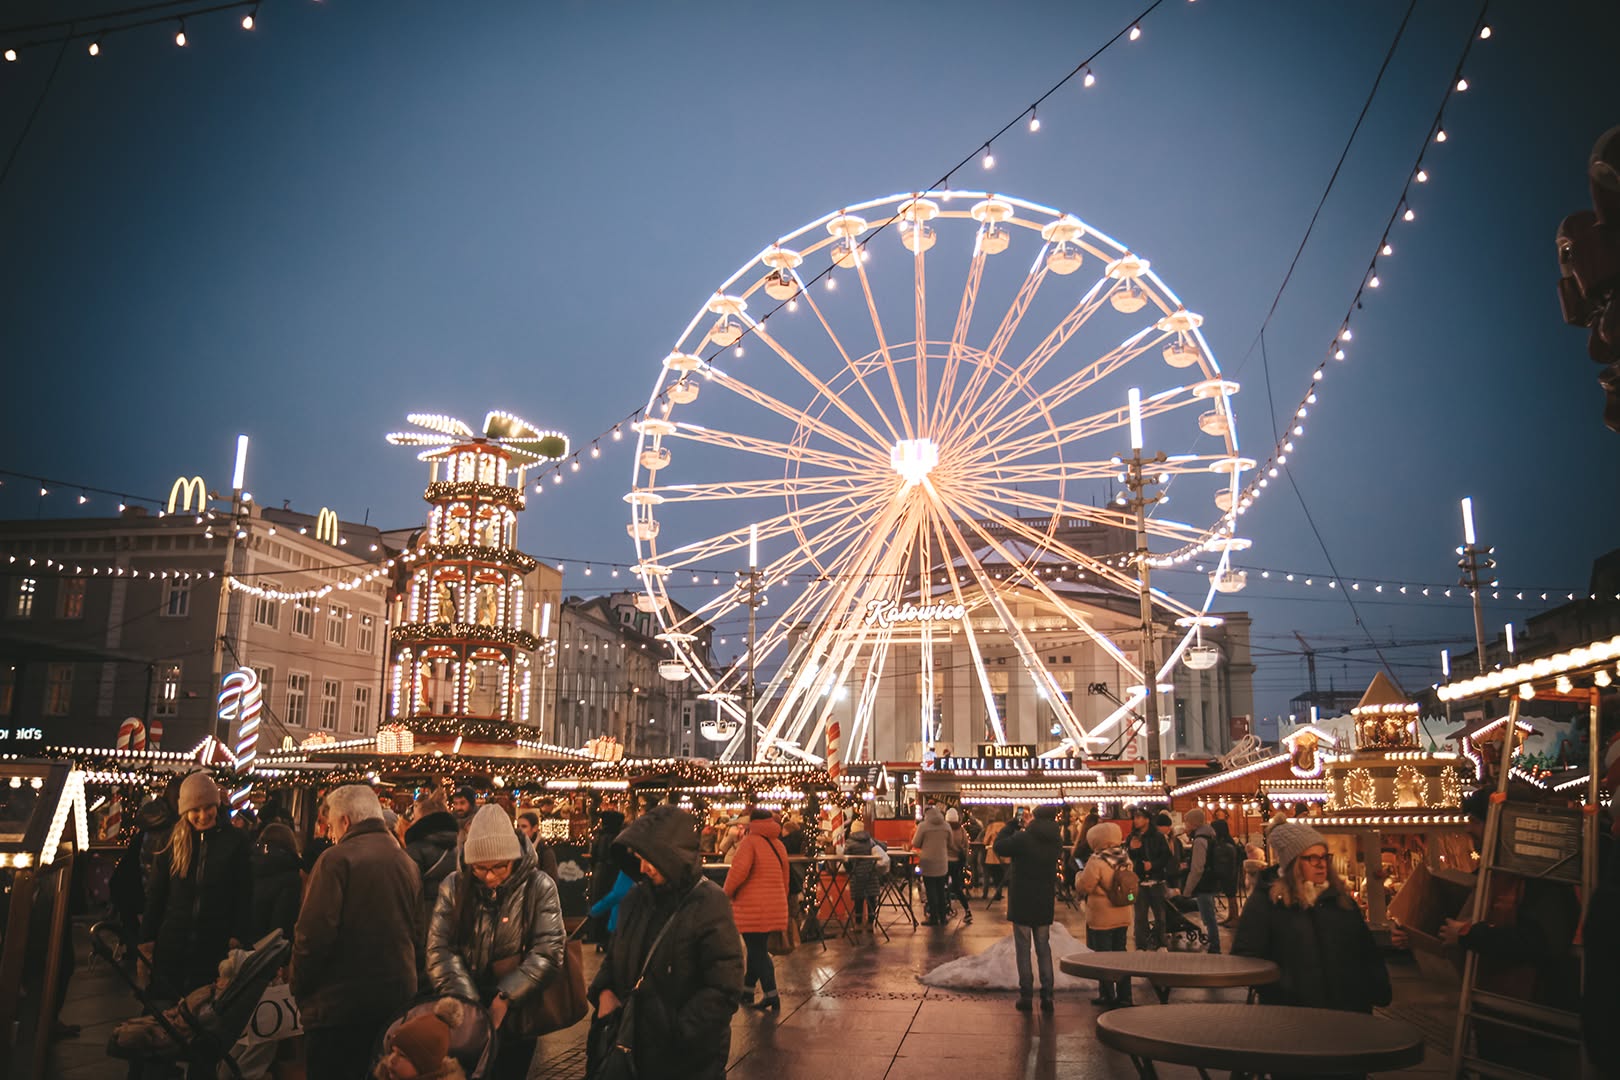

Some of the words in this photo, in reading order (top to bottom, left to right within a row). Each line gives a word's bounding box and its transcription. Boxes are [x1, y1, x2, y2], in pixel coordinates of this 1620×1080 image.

[865, 599, 966, 629] Katowice
[995, 746, 1029, 757] BULWA
[940, 757, 985, 770] FRYTKI
[994, 757, 1075, 770] BELGIJSKIE
